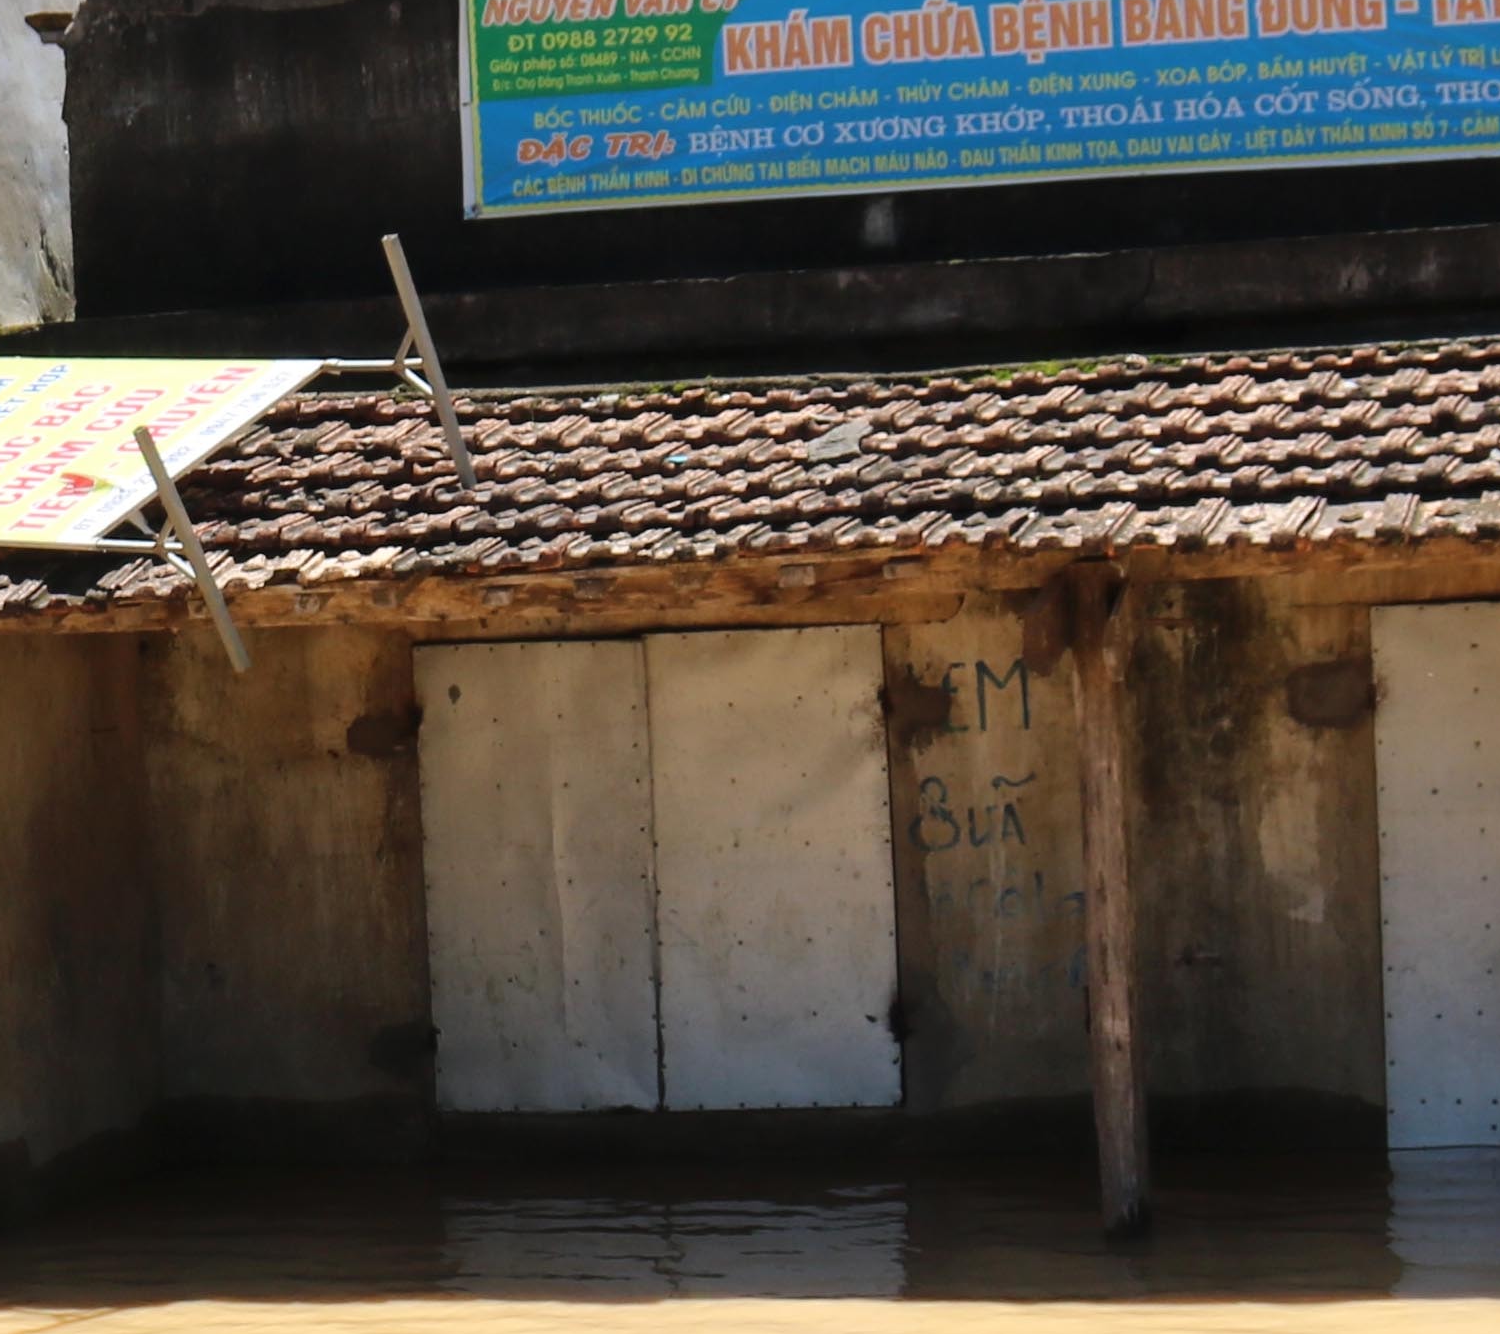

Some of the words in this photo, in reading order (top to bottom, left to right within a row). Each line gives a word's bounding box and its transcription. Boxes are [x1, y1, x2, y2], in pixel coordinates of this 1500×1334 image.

[508, 34, 536, 53] ĐT
[541, 29, 596, 50] 0988
[603, 25, 658, 47] 2729
[664, 23, 693, 42] 92
[722, 9, 853, 76] KHÁM
[1079, 69, 1136, 91] XUNG
[1156, 67, 1202, 86] XOA
[517, 132, 593, 166] ĐẶC
[688, 125, 777, 157] BỆNH
[834, 116, 947, 144] XƯƠNG
[759, 163, 784, 181] TAI
